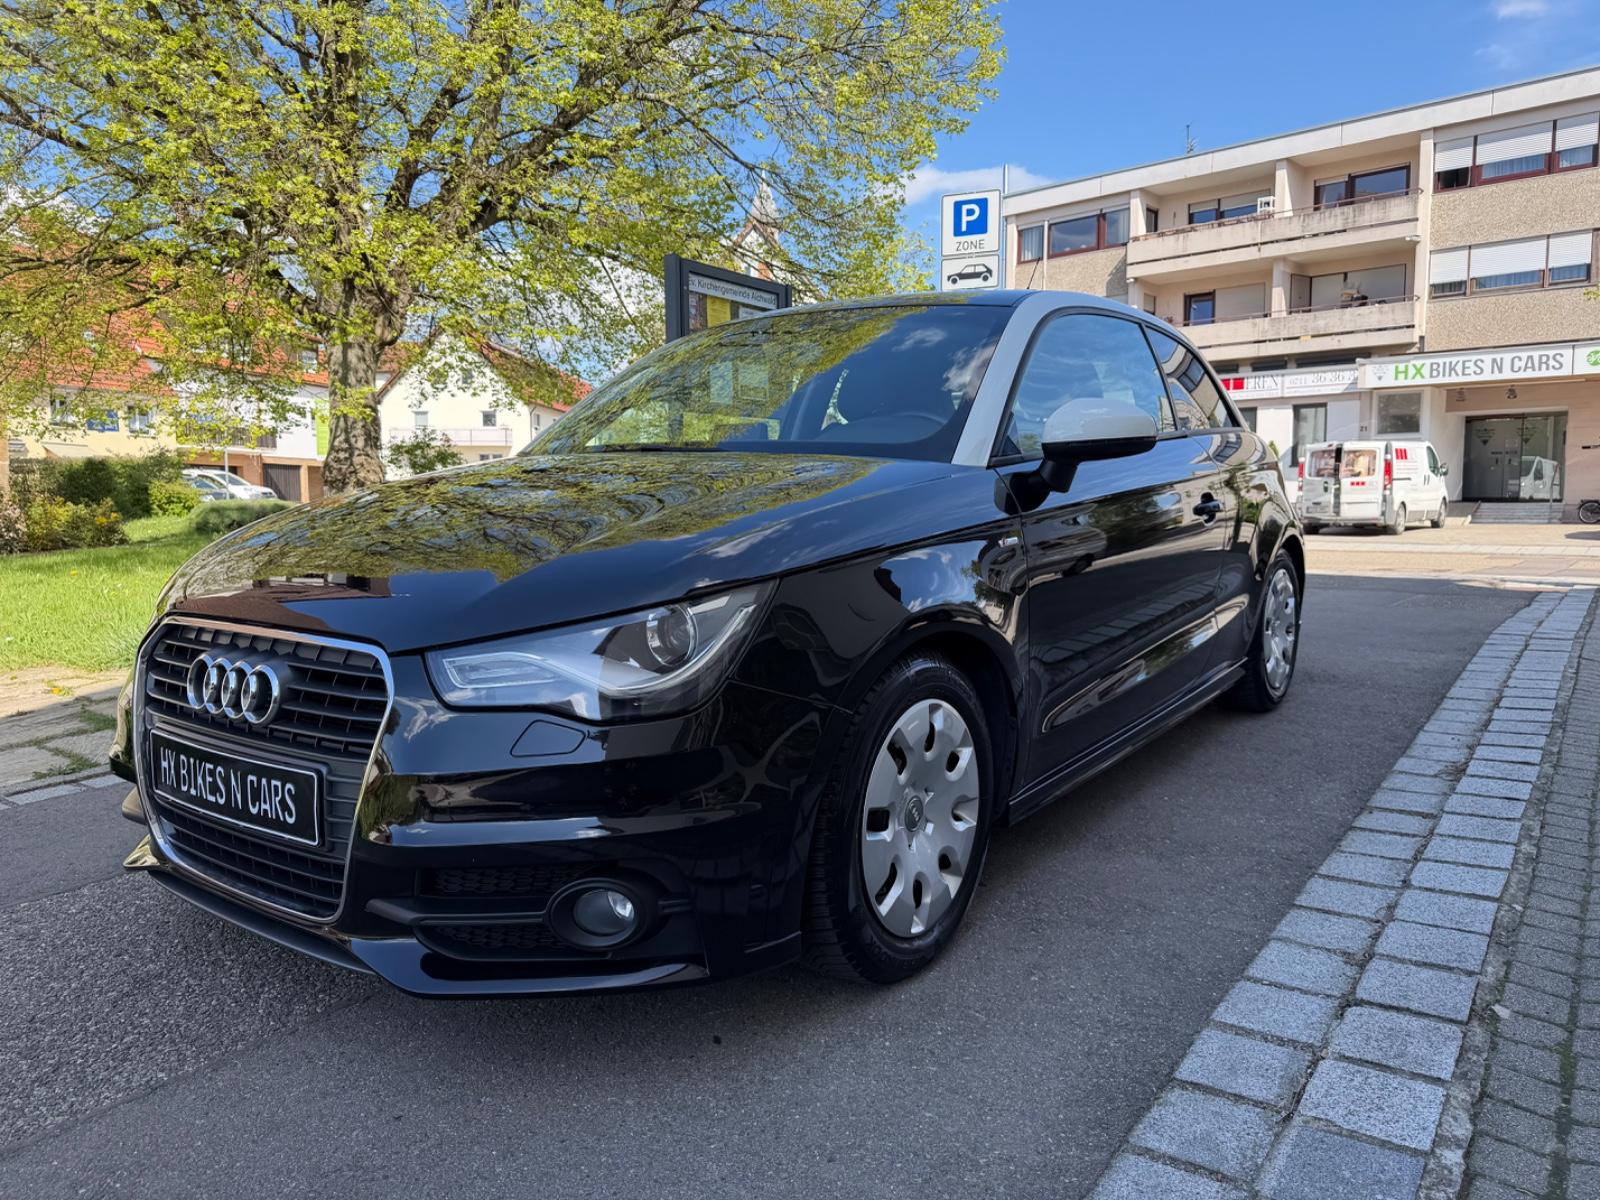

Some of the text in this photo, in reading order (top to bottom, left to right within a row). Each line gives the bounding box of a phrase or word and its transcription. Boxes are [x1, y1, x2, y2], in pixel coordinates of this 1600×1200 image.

[961, 203, 980, 232] P
[955, 239, 985, 251] ZONE
[1394, 363, 1426, 382] HX
[1429, 358, 1485, 379] BIKES
[1490, 356, 1504, 375] N
[1510, 352, 1565, 374] CARS
[160, 746, 297, 825] HX BIKES N CARS
